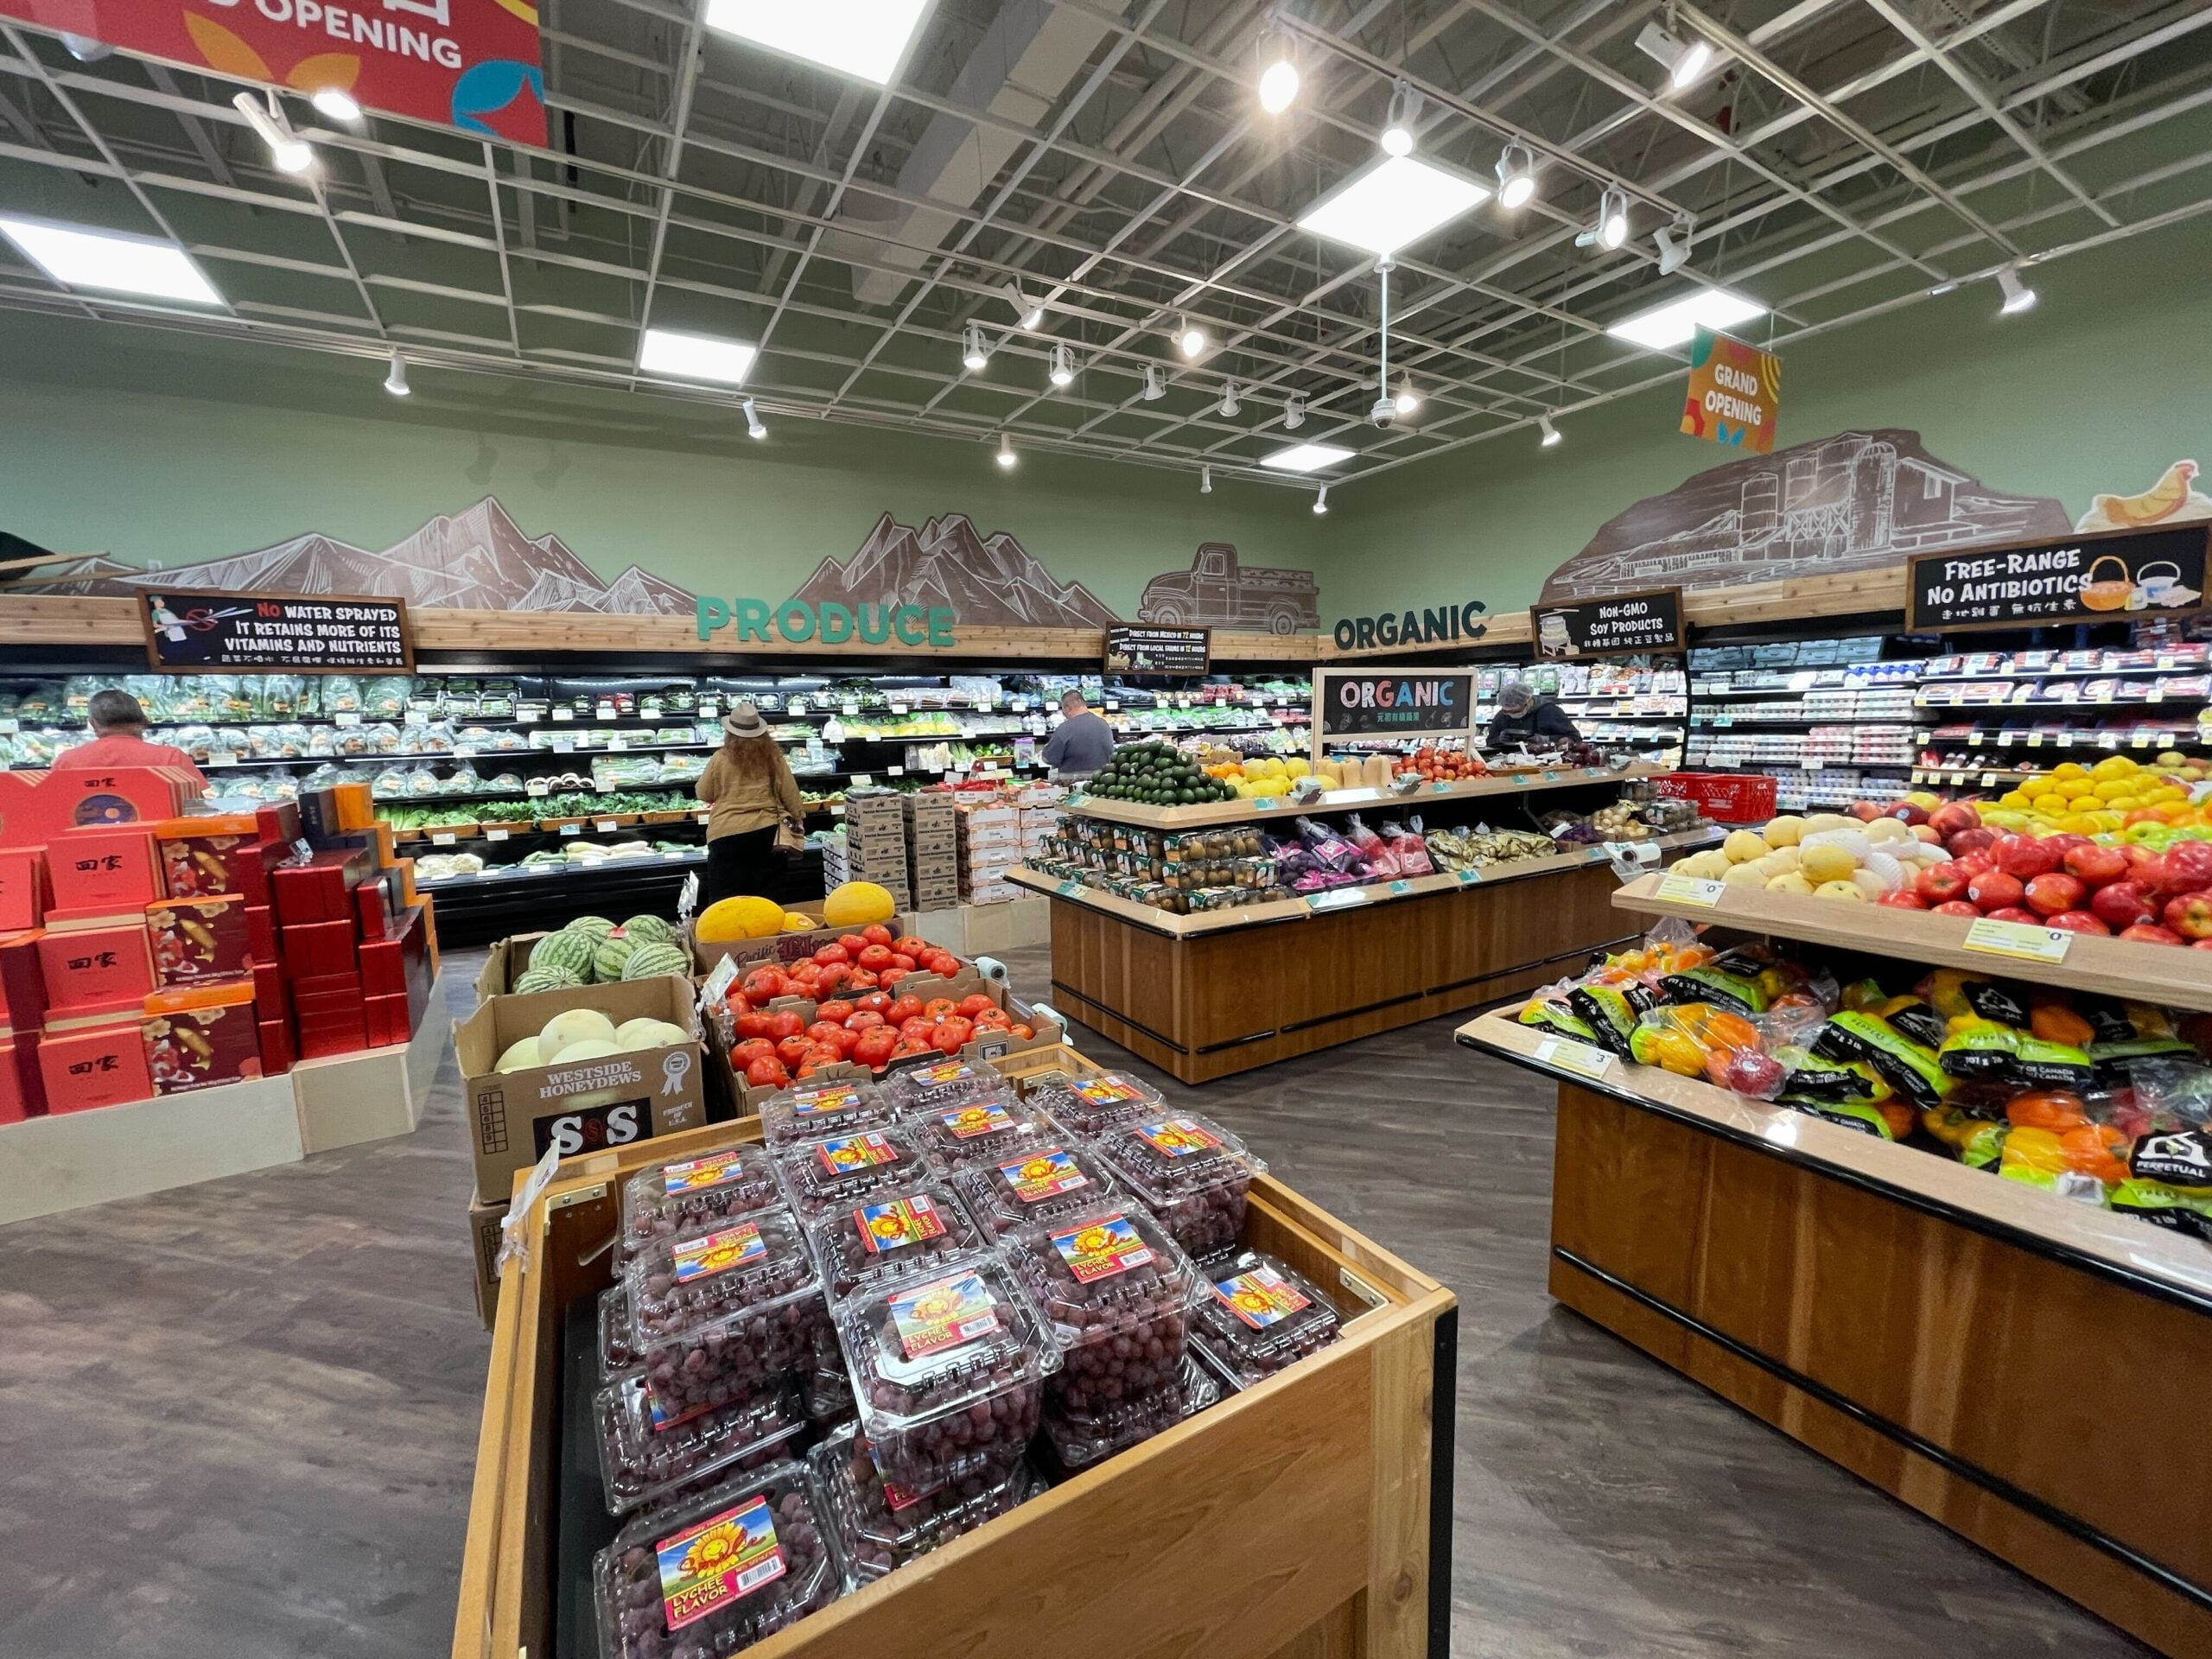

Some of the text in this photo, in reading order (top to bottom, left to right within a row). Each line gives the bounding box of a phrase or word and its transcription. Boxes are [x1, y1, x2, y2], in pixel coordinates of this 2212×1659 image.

[257, 0, 461, 69] OPENING
[1714, 363, 1758, 397] GRAND
[1705, 390, 1762, 426] OPENING
[1944, 548, 2082, 582] FREE-RANGE
[1960, 573, 2094, 598] ANTIBIOTICS
[257, 603, 397, 622] NO WATER SPRAYED
[696, 595, 955, 646] PRODUCE
[236, 620, 400, 639] IT RETAINS MORE OF ITS
[1334, 601, 1487, 651] ORGANIC
[1611, 618, 1663, 633] PRODUCTS
[224, 638, 401, 653] VITAMINS AND NUTRIENTS
[1340, 680, 1454, 709] ORGANIC
[547, 1061, 632, 1084] WESTSIDE
[2039, 1066, 2075, 1076] CANADA
[539, 1071, 641, 1098] HONEYDEWS
[2137, 1160, 2206, 1178] PERPETUAL
[1076, 1256, 1110, 1270] LYCHEE
[1080, 1262, 1115, 1277] FLAVOR
[908, 1325, 949, 1343] LYCHEE
[911, 1332, 952, 1351] FLAVOR
[673, 1576, 724, 1606] LYCHEE
[674, 1586, 728, 1618] FLAVOR
